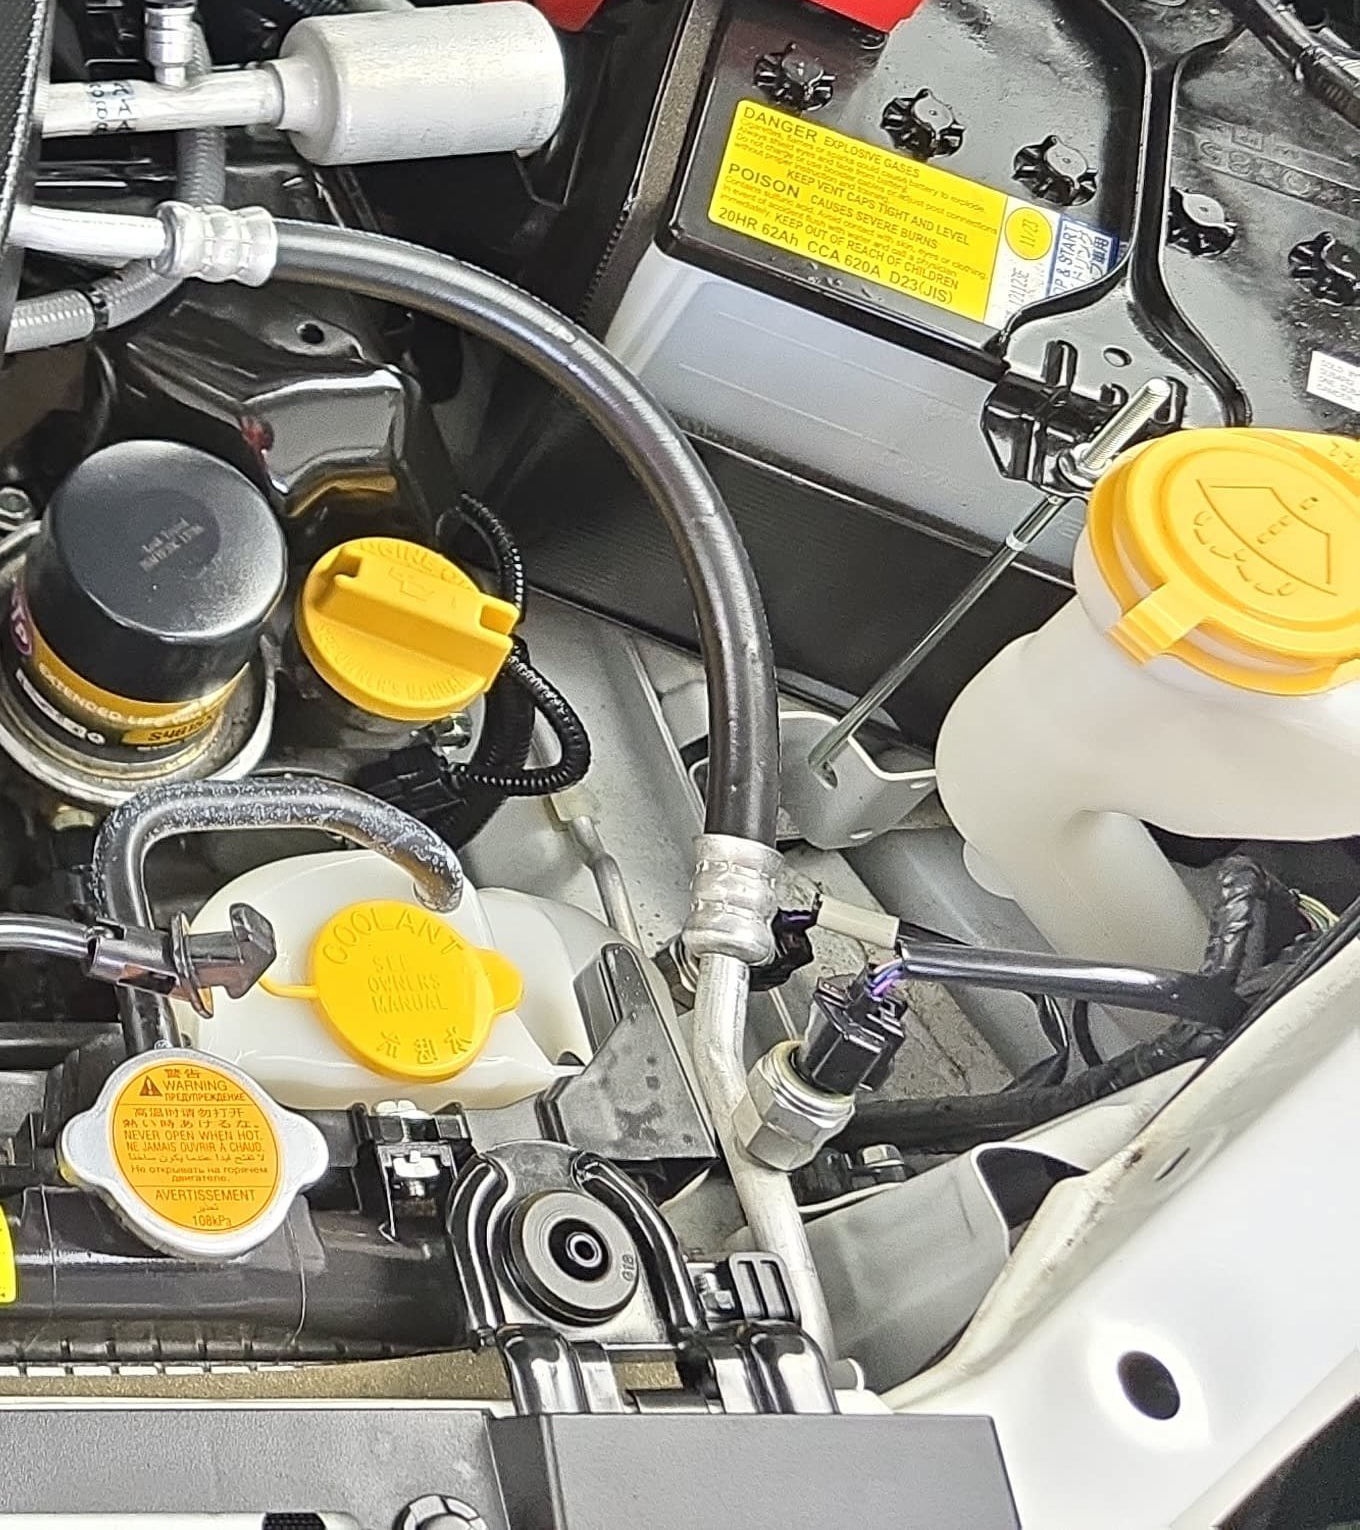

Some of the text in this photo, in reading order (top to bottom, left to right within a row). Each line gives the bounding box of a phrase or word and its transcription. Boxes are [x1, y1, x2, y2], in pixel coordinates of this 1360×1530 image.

[735, 132, 749, 143] Do
[749, 137, 764, 149] not
[764, 143, 794, 160] charge
[742, 105, 920, 179] DANGER EXPLOSIVE GASES
[817, 154, 833, 166] and
[727, 162, 939, 250] POISON CAUSES SEVERE BURNS
[785, 168, 971, 245] KEEP VENT CAPS TIGHT AND LEVEL
[939, 190, 949, 199] to
[1019, 218, 1039, 248] 11/23
[1057, 224, 1079, 267] START
[717, 205, 954, 305] 20HR 62Ah CCA 620A D23(JIS)
[773, 212, 804, 232] KEEP
[804, 223, 828, 241] OUT
[828, 232, 845, 247] OF
[846, 239, 884, 262] REACH
[886, 254, 901, 268] OF
[903, 260, 959, 290] CHILDREN
[322, 907, 464, 965] COOLANT
[371, 992, 448, 1014] MANUAL
[162, 1080, 228, 1091] WARNING
[164, 1092, 247, 1102] ПРЕДУПРЕЖДЕНИЕ
[123, 1129, 264, 1140] NEVER OPEN WHEN HOT.
[126, 1141, 265, 1152] NE JAMAIS OUVRIR CHAUD.
[155, 1189, 256, 1201] AVERTISSEMENT
[192, 1214, 232, 1227] 108kPa
